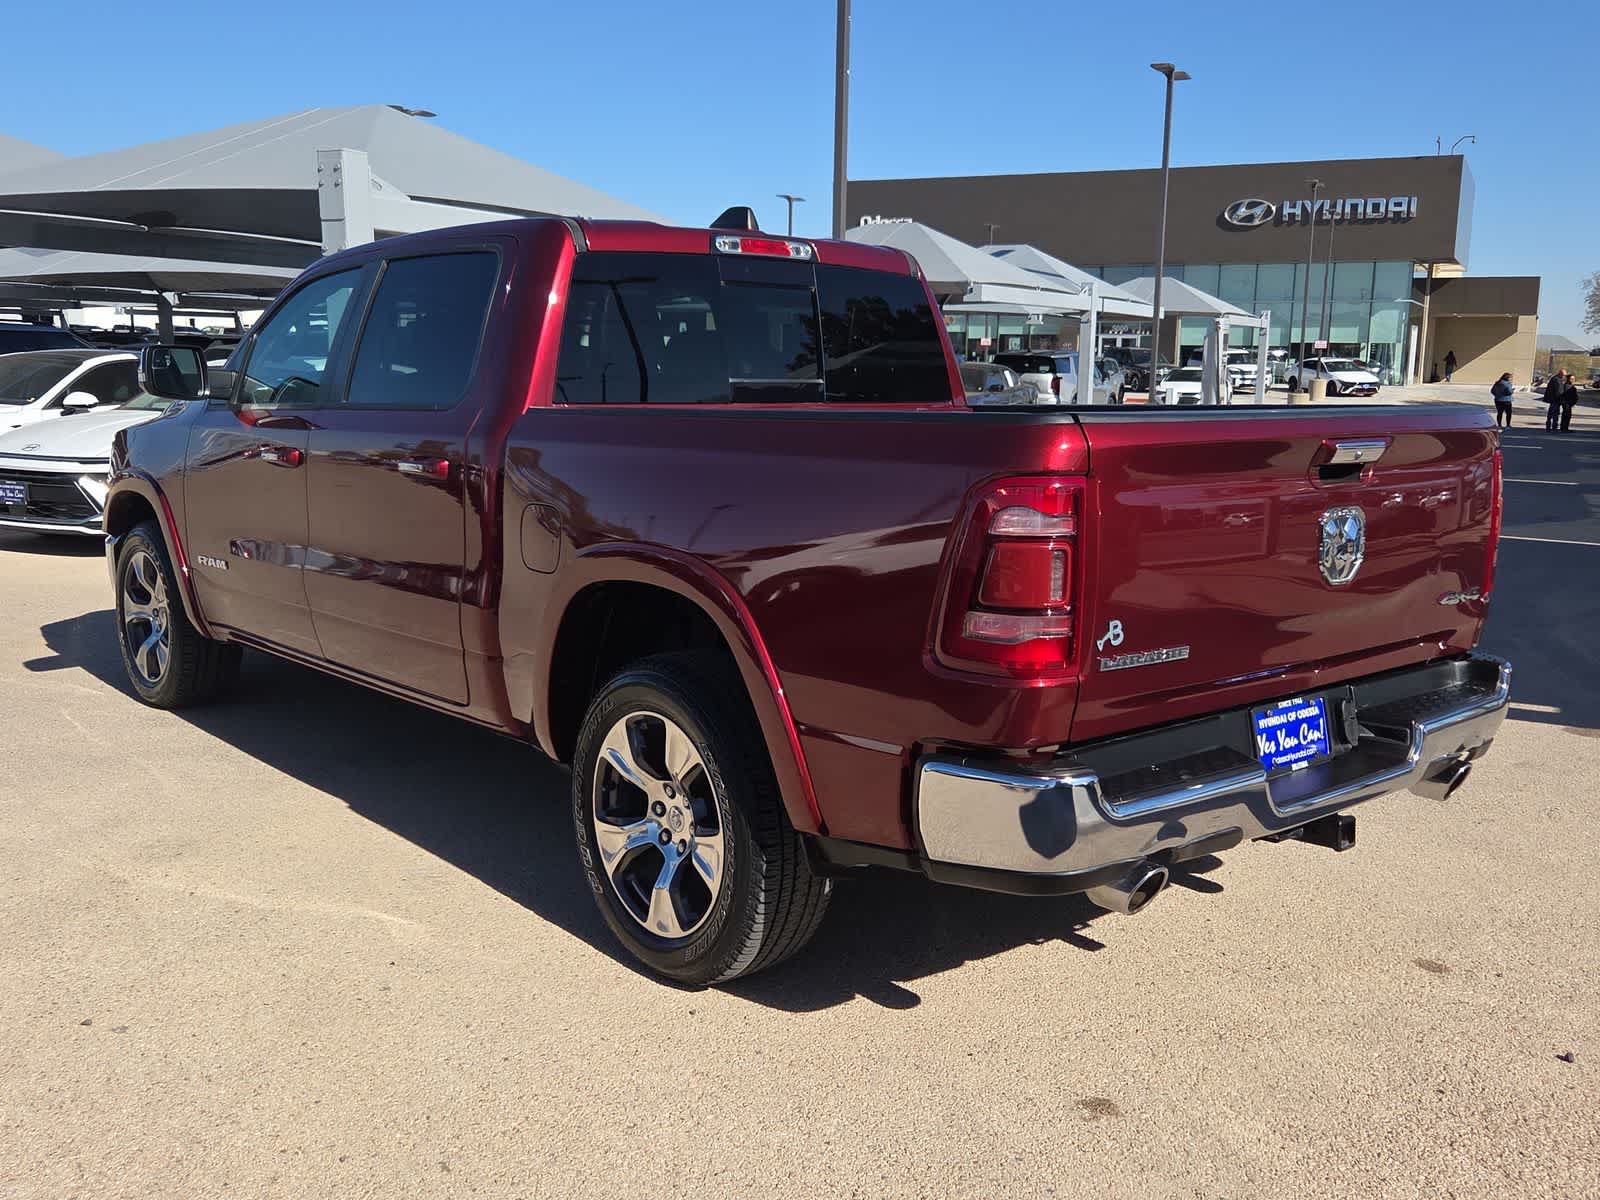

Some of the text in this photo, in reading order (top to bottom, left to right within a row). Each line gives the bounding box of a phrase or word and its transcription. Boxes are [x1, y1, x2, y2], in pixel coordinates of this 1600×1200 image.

[1282, 196, 1418, 221] HYUNDAI
[198, 555, 229, 570] RAM
[1258, 706, 1319, 729] HYUNDAI OF ODESSA
[1256, 718, 1324, 756] Yes You Can!
